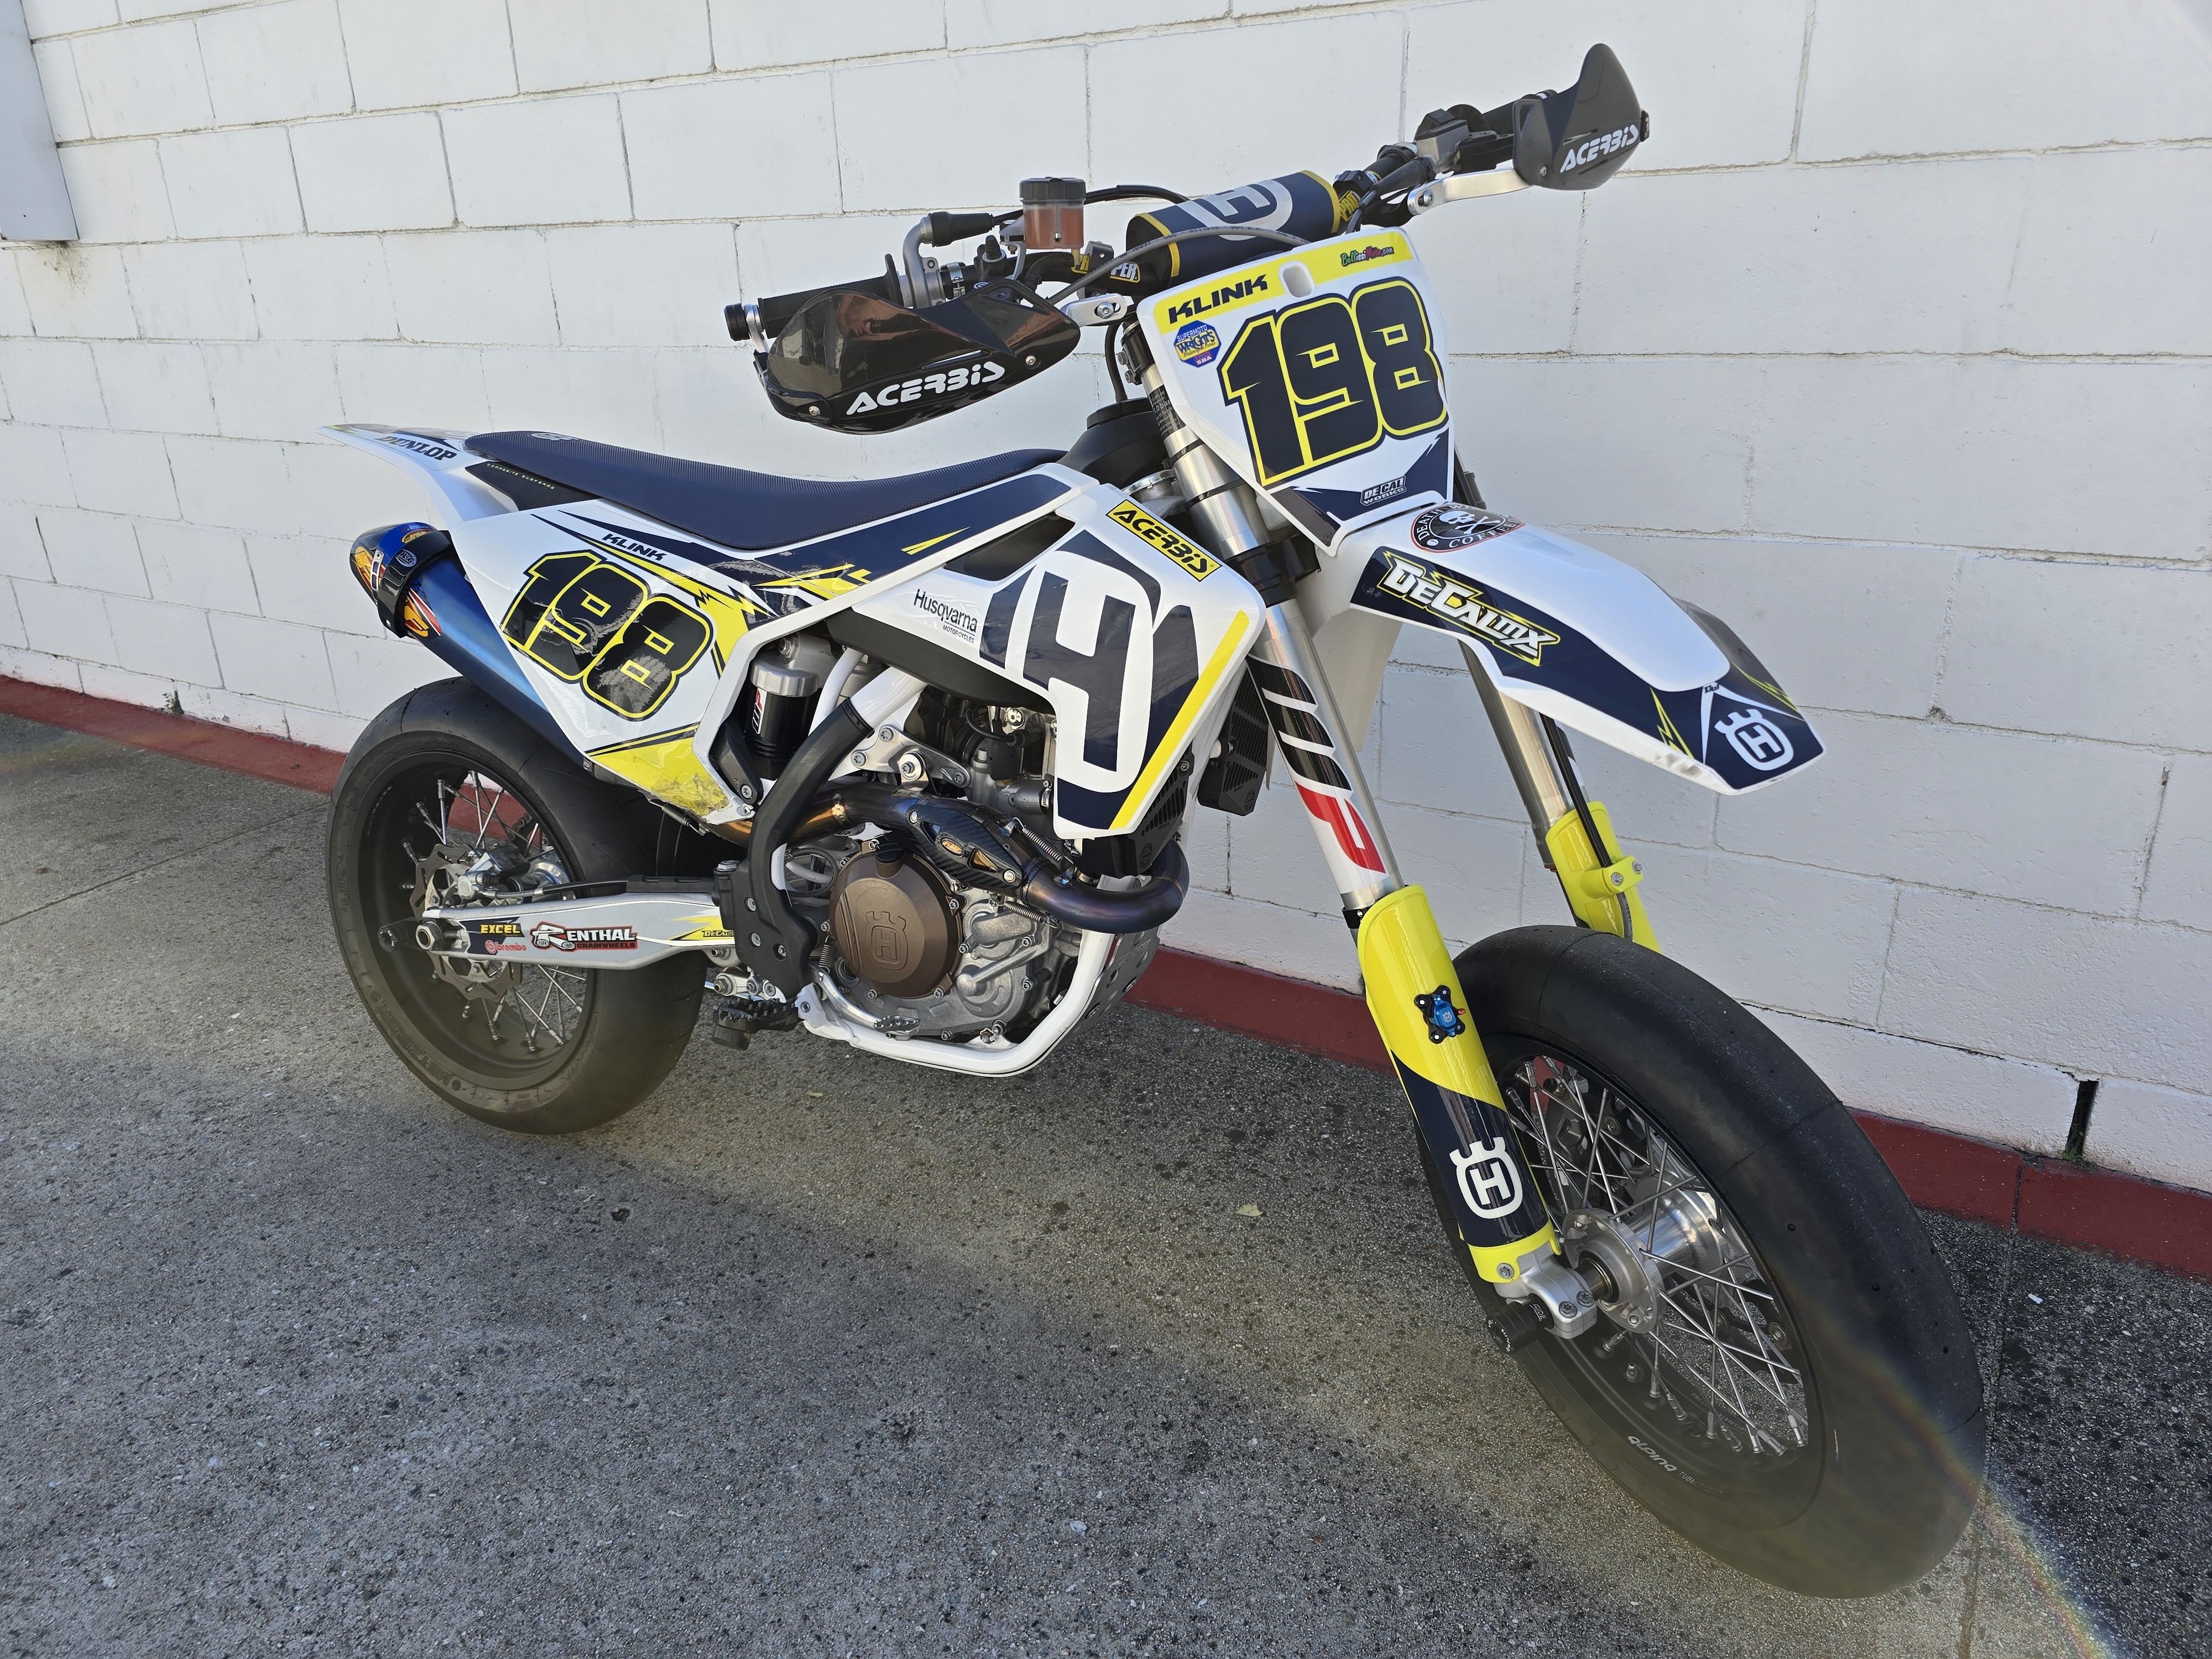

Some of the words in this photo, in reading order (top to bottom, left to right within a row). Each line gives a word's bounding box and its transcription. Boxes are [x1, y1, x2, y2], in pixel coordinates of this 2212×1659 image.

[1168, 273, 1269, 325] KLINK
[1177, 324, 1208, 342] SUPERMOTO
[1218, 278, 1449, 488] 198
[374, 436, 457, 461] DUNLOP
[487, 463, 519, 476] COMPOSITE
[521, 474, 555, 490] SUBFRAME
[1364, 477, 1404, 500] DECAL
[1363, 487, 1405, 504] WORKS
[1416, 508, 1444, 541] DEATH
[1448, 523, 1516, 549] COFFEE
[601, 533, 668, 562] KLINK
[913, 588, 978, 633] Husqvarna
[502, 550, 714, 721] 198
[942, 624, 975, 644] MOTORCYCLES
[480, 924, 520, 934] EXCEL
[532, 924, 635, 950] RENTHAL
[497, 940, 526, 951] brembo
